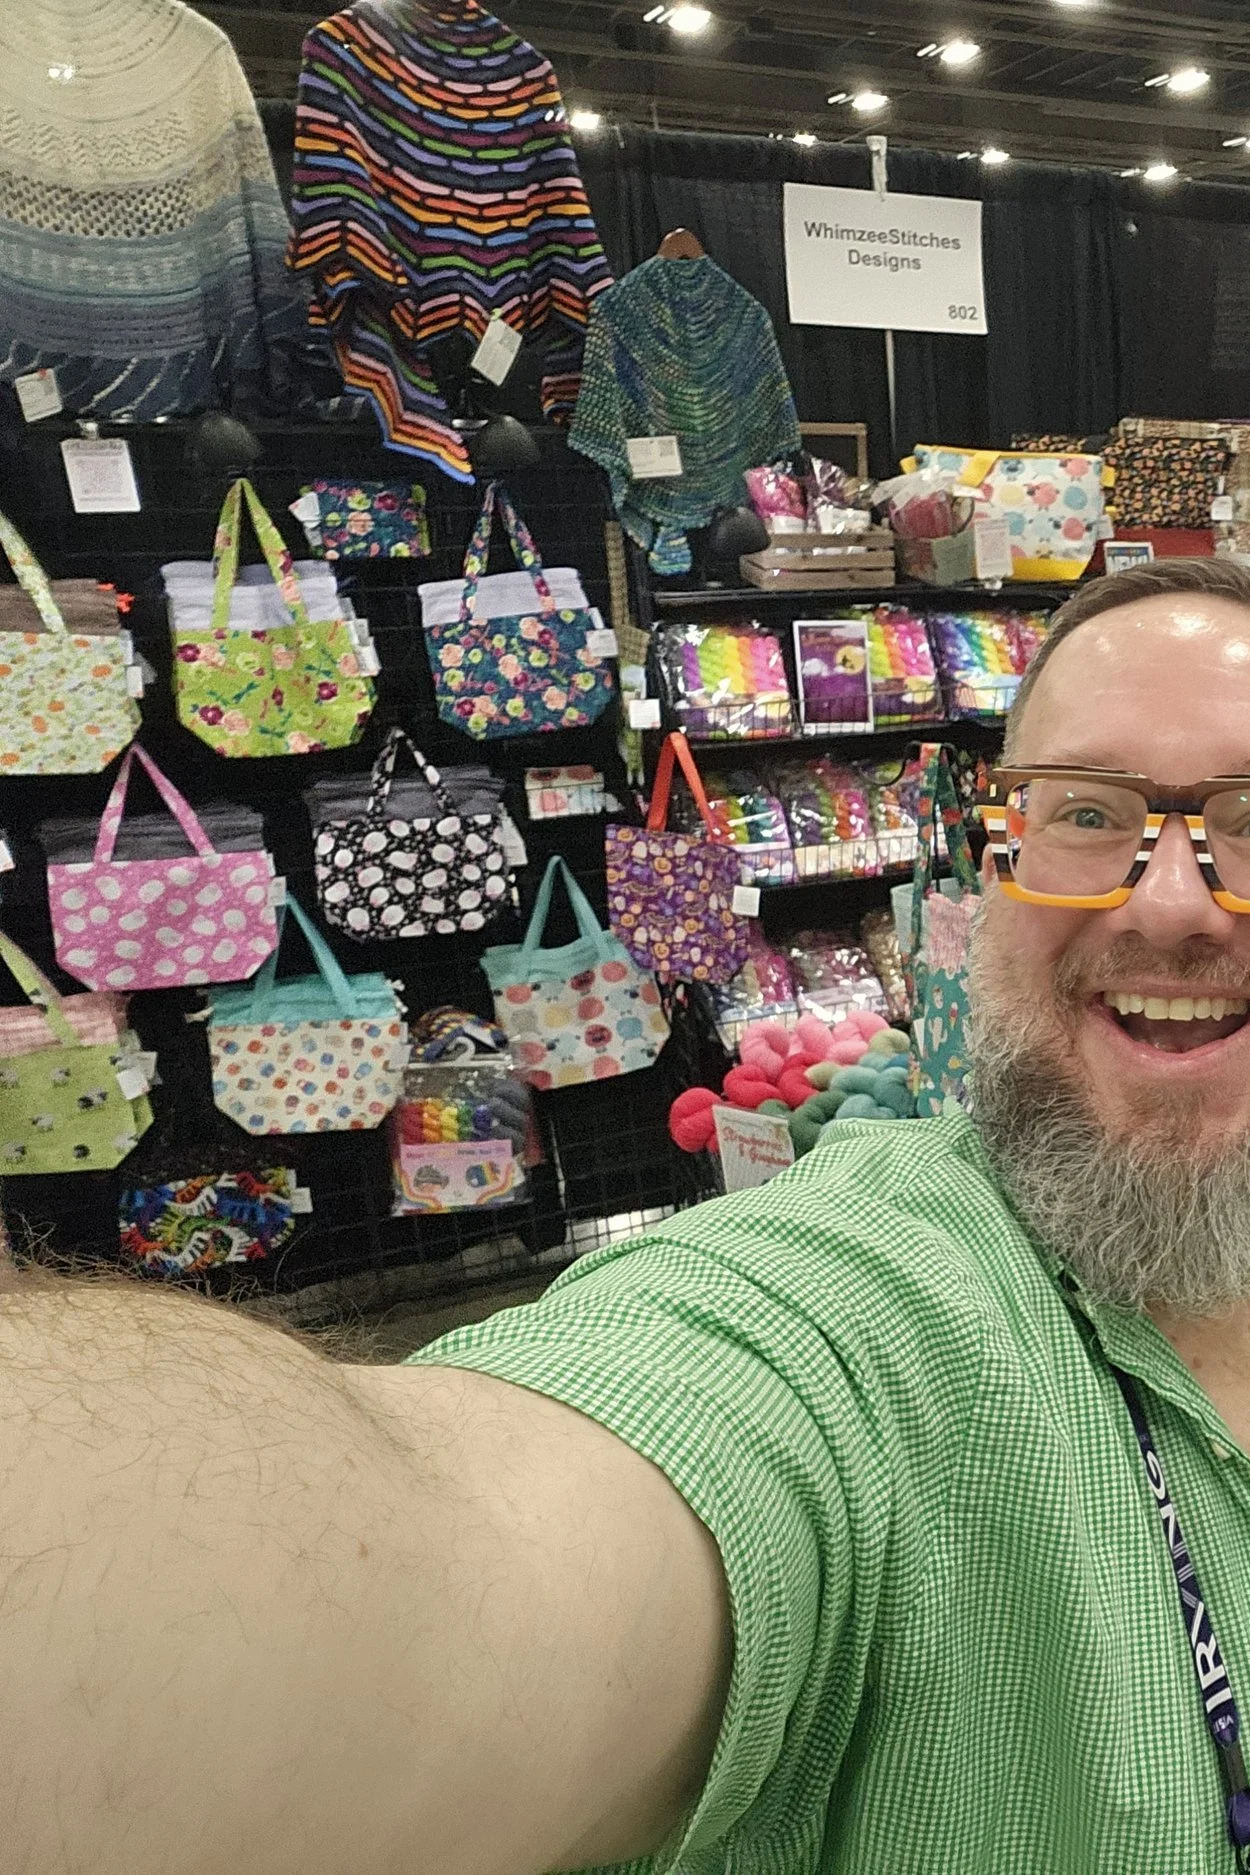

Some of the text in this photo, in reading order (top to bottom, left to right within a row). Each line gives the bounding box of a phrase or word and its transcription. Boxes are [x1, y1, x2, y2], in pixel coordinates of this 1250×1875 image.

[804, 221, 961, 250] WhimzeeStitches
[848, 250, 922, 272] Designs
[948, 305, 978, 321] 802
[1147, 1450, 1234, 1714] IRVING
